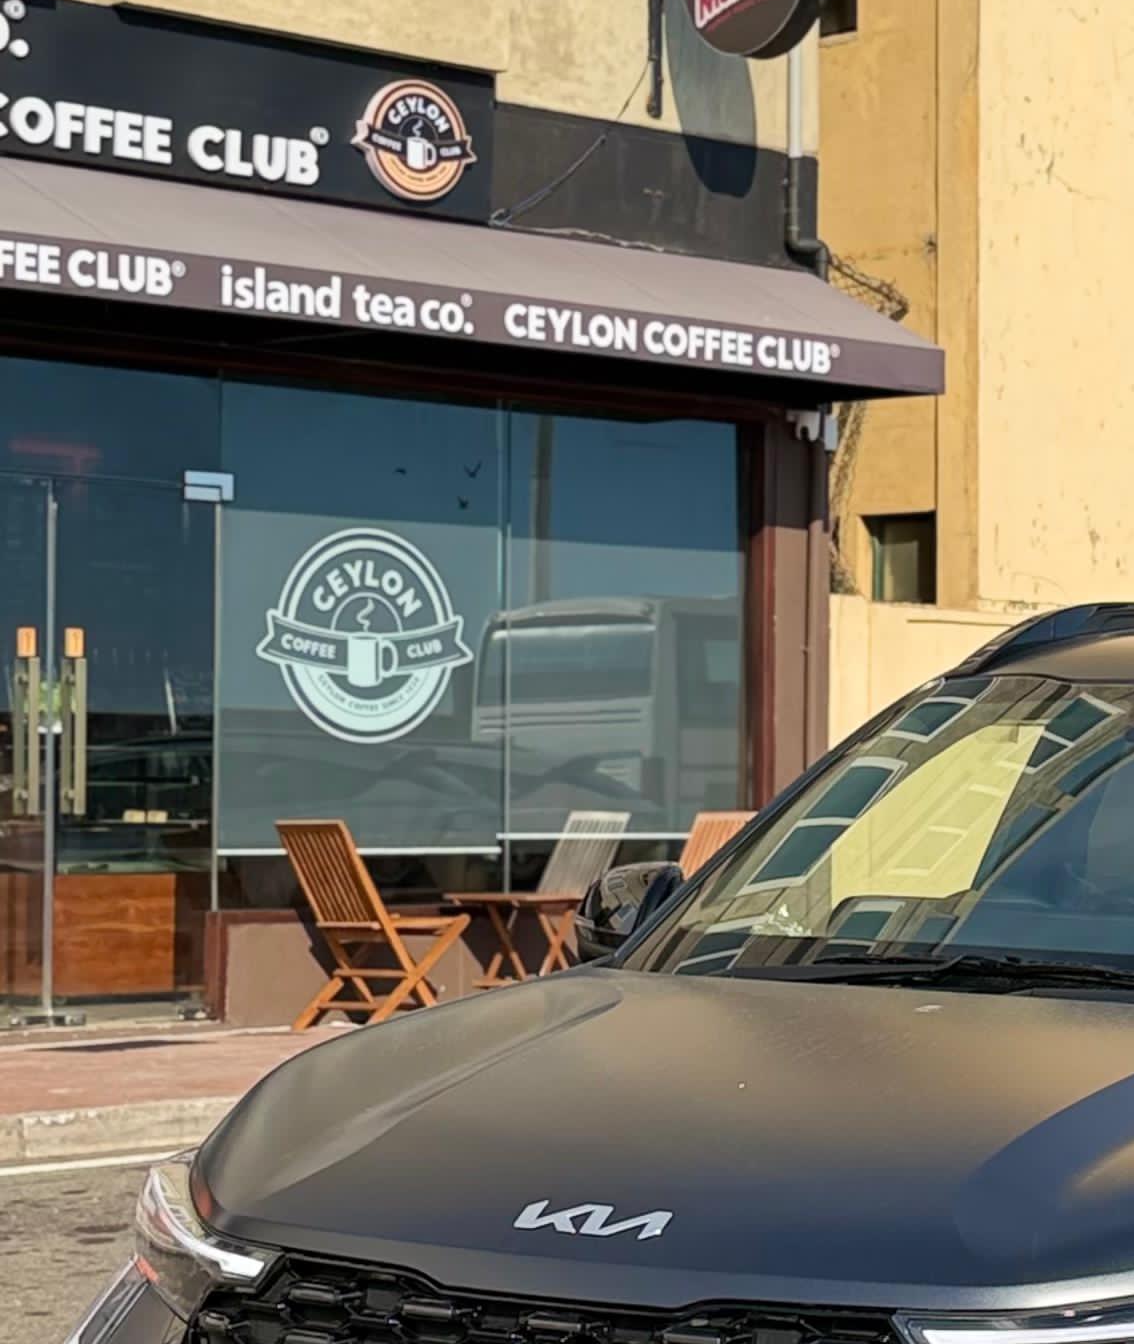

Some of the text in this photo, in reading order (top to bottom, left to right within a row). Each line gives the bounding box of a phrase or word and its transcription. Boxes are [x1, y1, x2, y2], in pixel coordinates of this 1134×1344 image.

[0, 93, 173, 165] OFFEE
[387, 96, 451, 134] CEYLON
[221, 264, 342, 319] island
[352, 284, 416, 328] tea
[504, 303, 638, 352] CEYLON
[643, 321, 753, 366] COFFEE
[312, 559, 423, 618] CEYLON
[280, 633, 443, 659] COFFEE CLUB
